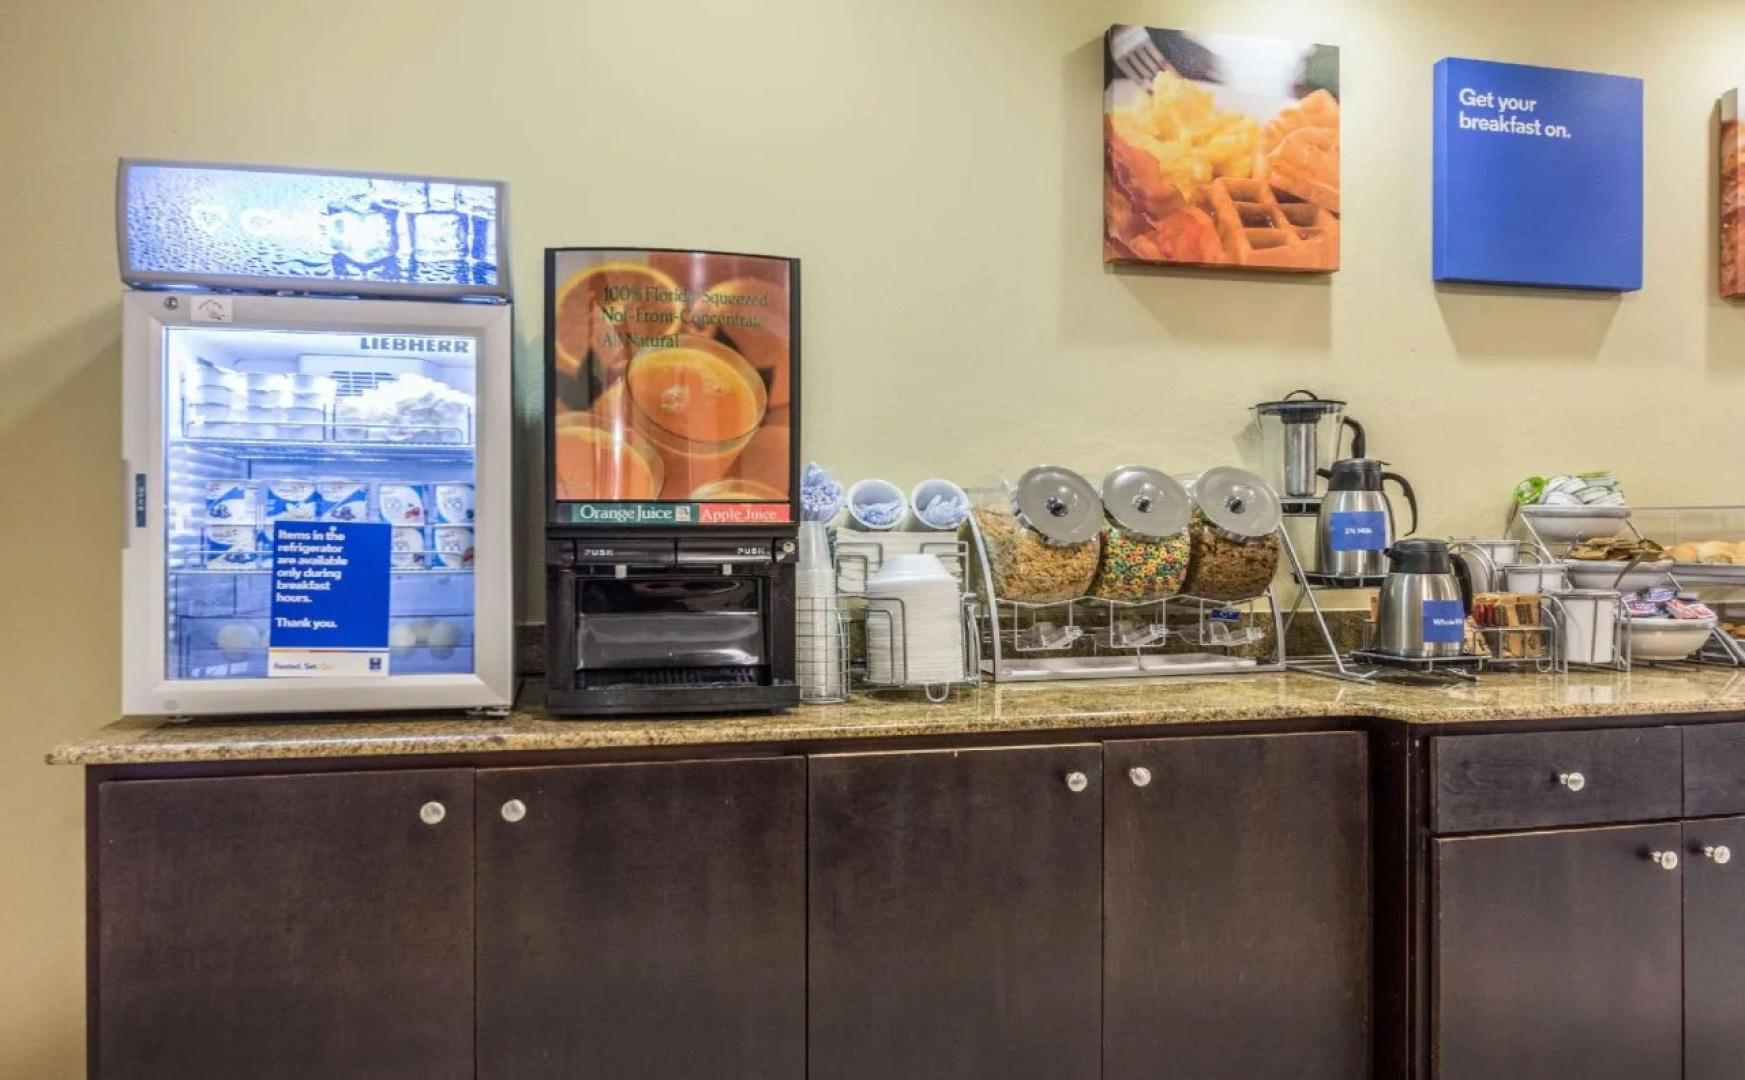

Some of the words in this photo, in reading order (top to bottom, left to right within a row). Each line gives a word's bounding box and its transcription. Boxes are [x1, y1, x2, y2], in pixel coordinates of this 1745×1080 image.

[1459, 88, 1494, 108] Get
[1498, 96, 1537, 112] your
[1459, 110, 1541, 136] breakfast
[1545, 124, 1571, 138] on.
[603, 285, 643, 302] 100%
[645, 287, 693, 304] Florid
[703, 290, 768, 309] Squeezed
[360, 337, 469, 353] LIEBHERR
[624, 332, 679, 348] Natural
[580, 504, 634, 522] Orange
[636, 504, 673, 520] Juice
[702, 508, 743, 522] Apple
[744, 508, 777, 520] Juice
[277, 529, 311, 540] Items
[313, 529, 324, 540] in
[326, 528, 345, 541] the
[277, 542, 344, 554] refrigerator
[584, 548, 614, 556] PUSH
[737, 546, 766, 555] PUSH
[277, 557, 297, 565] are
[298, 555, 348, 566] available
[276, 567, 302, 580] only
[303, 568, 342, 580] during
[276, 580, 331, 591] breakfast
[276, 592, 313, 603] hours.
[275, 617, 312, 628] Thank
[313, 620, 338, 630] you.
